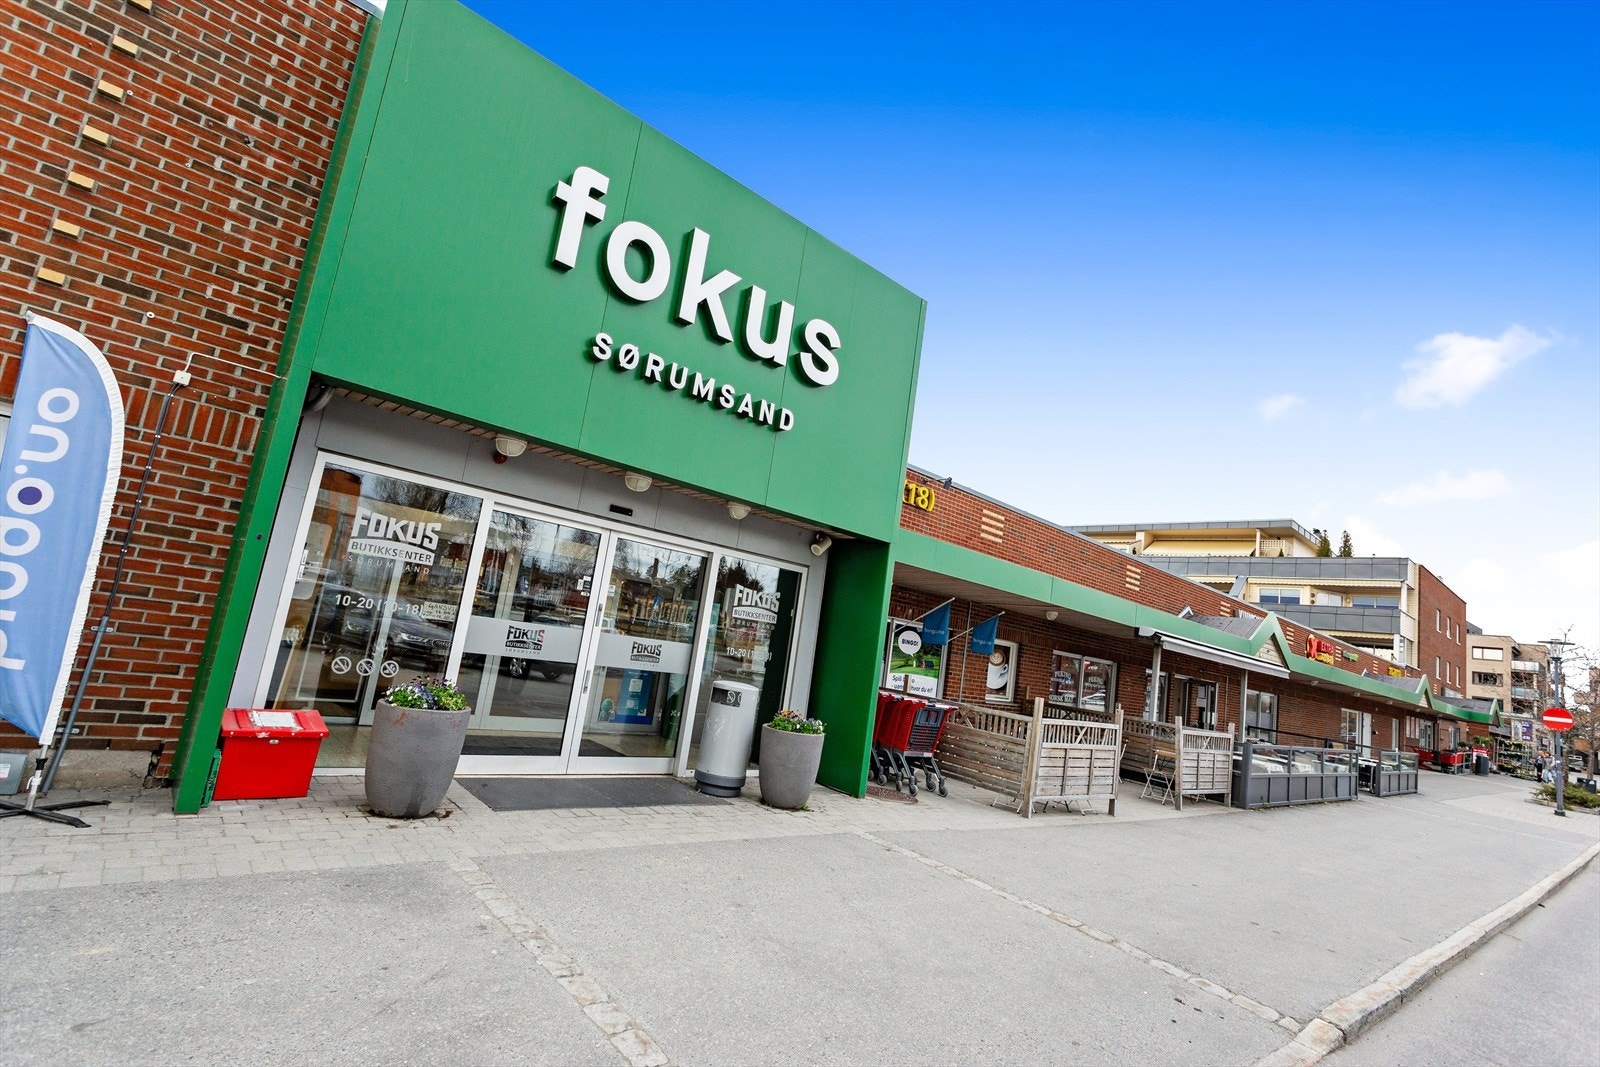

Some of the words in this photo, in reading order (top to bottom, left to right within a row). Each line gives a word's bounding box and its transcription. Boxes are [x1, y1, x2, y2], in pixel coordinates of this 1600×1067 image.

[552, 166, 841, 386] fokus
[591, 332, 795, 432] SØRUMSAND
[351, 506, 442, 551] FOKUS
[351, 541, 432, 563] BUTIKKSENTER
[348, 554, 430, 576] SØRUMAND
[335, 594, 374, 610] 10-20
[734, 584, 781, 613] FOKUS
[733, 609, 776, 622] BUTIKKSENTER
[506, 625, 545, 643] FOKUS
[901, 639, 919, 647] BINGO!
[631, 641, 662, 657] FOKUS
[727, 647, 747, 658] 10-20
